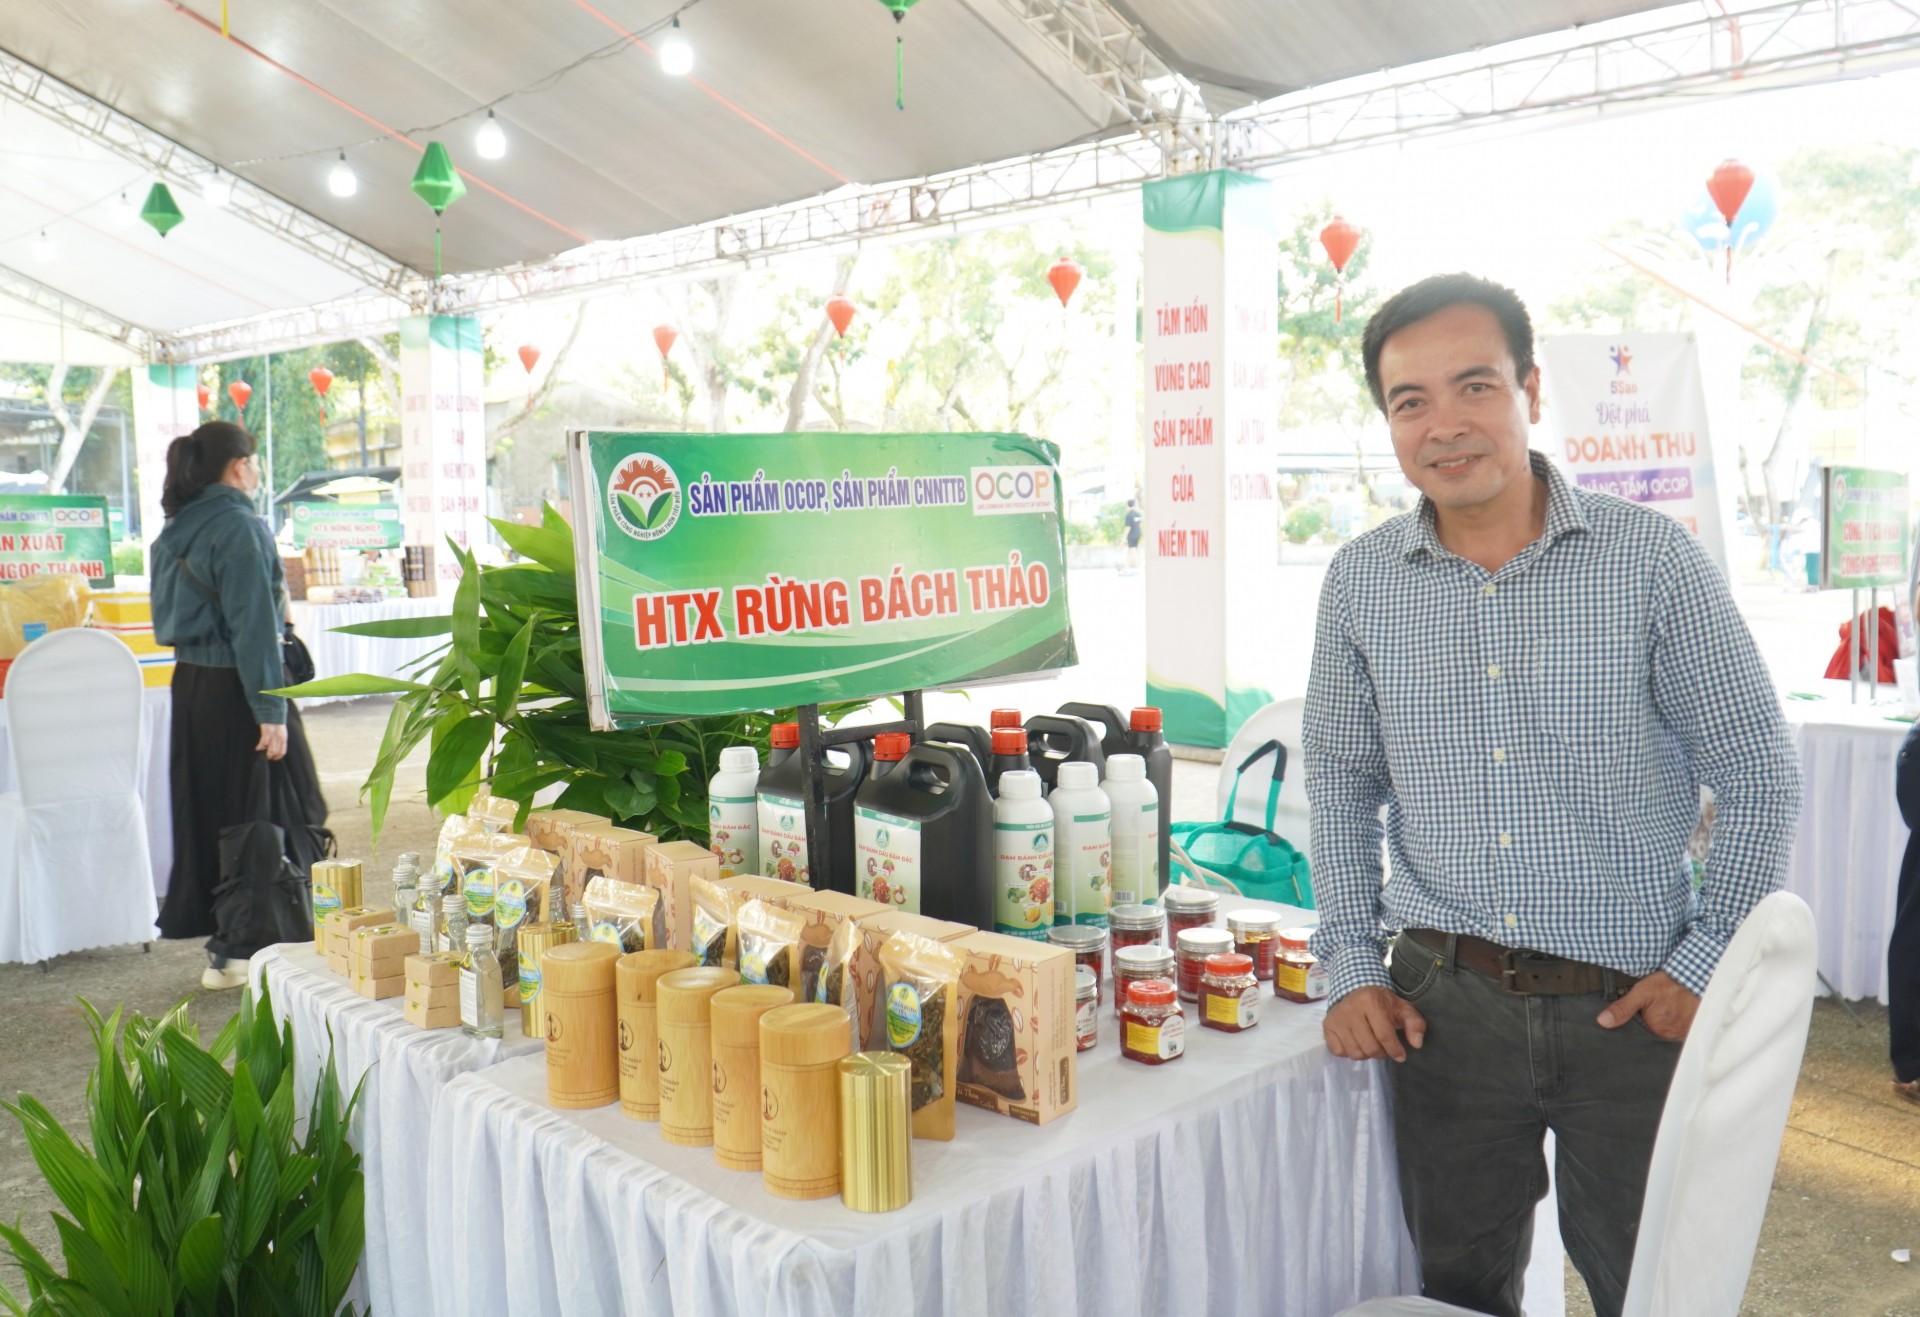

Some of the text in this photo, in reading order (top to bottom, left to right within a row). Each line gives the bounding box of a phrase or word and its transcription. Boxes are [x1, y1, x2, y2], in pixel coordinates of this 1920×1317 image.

[1188, 360, 1210, 390] CAO
[1610, 380, 1638, 395] 5Sao
[1596, 401, 1651, 430] Đột phá
[1564, 432, 1697, 463] DOANH THU
[691, 469, 966, 514] SẢN PHẨM OCOP, SẢN PHẨM CNNTTB
[975, 470, 1050, 500] OCOP
[1172, 464, 1195, 502] CỦA
[1651, 477, 1689, 494] OCOP
[55, 510, 100, 521] OCOP
[1191, 530, 1209, 557] TIN
[636, 552, 1048, 646] HTX RỪNG BÁCH THẢO
